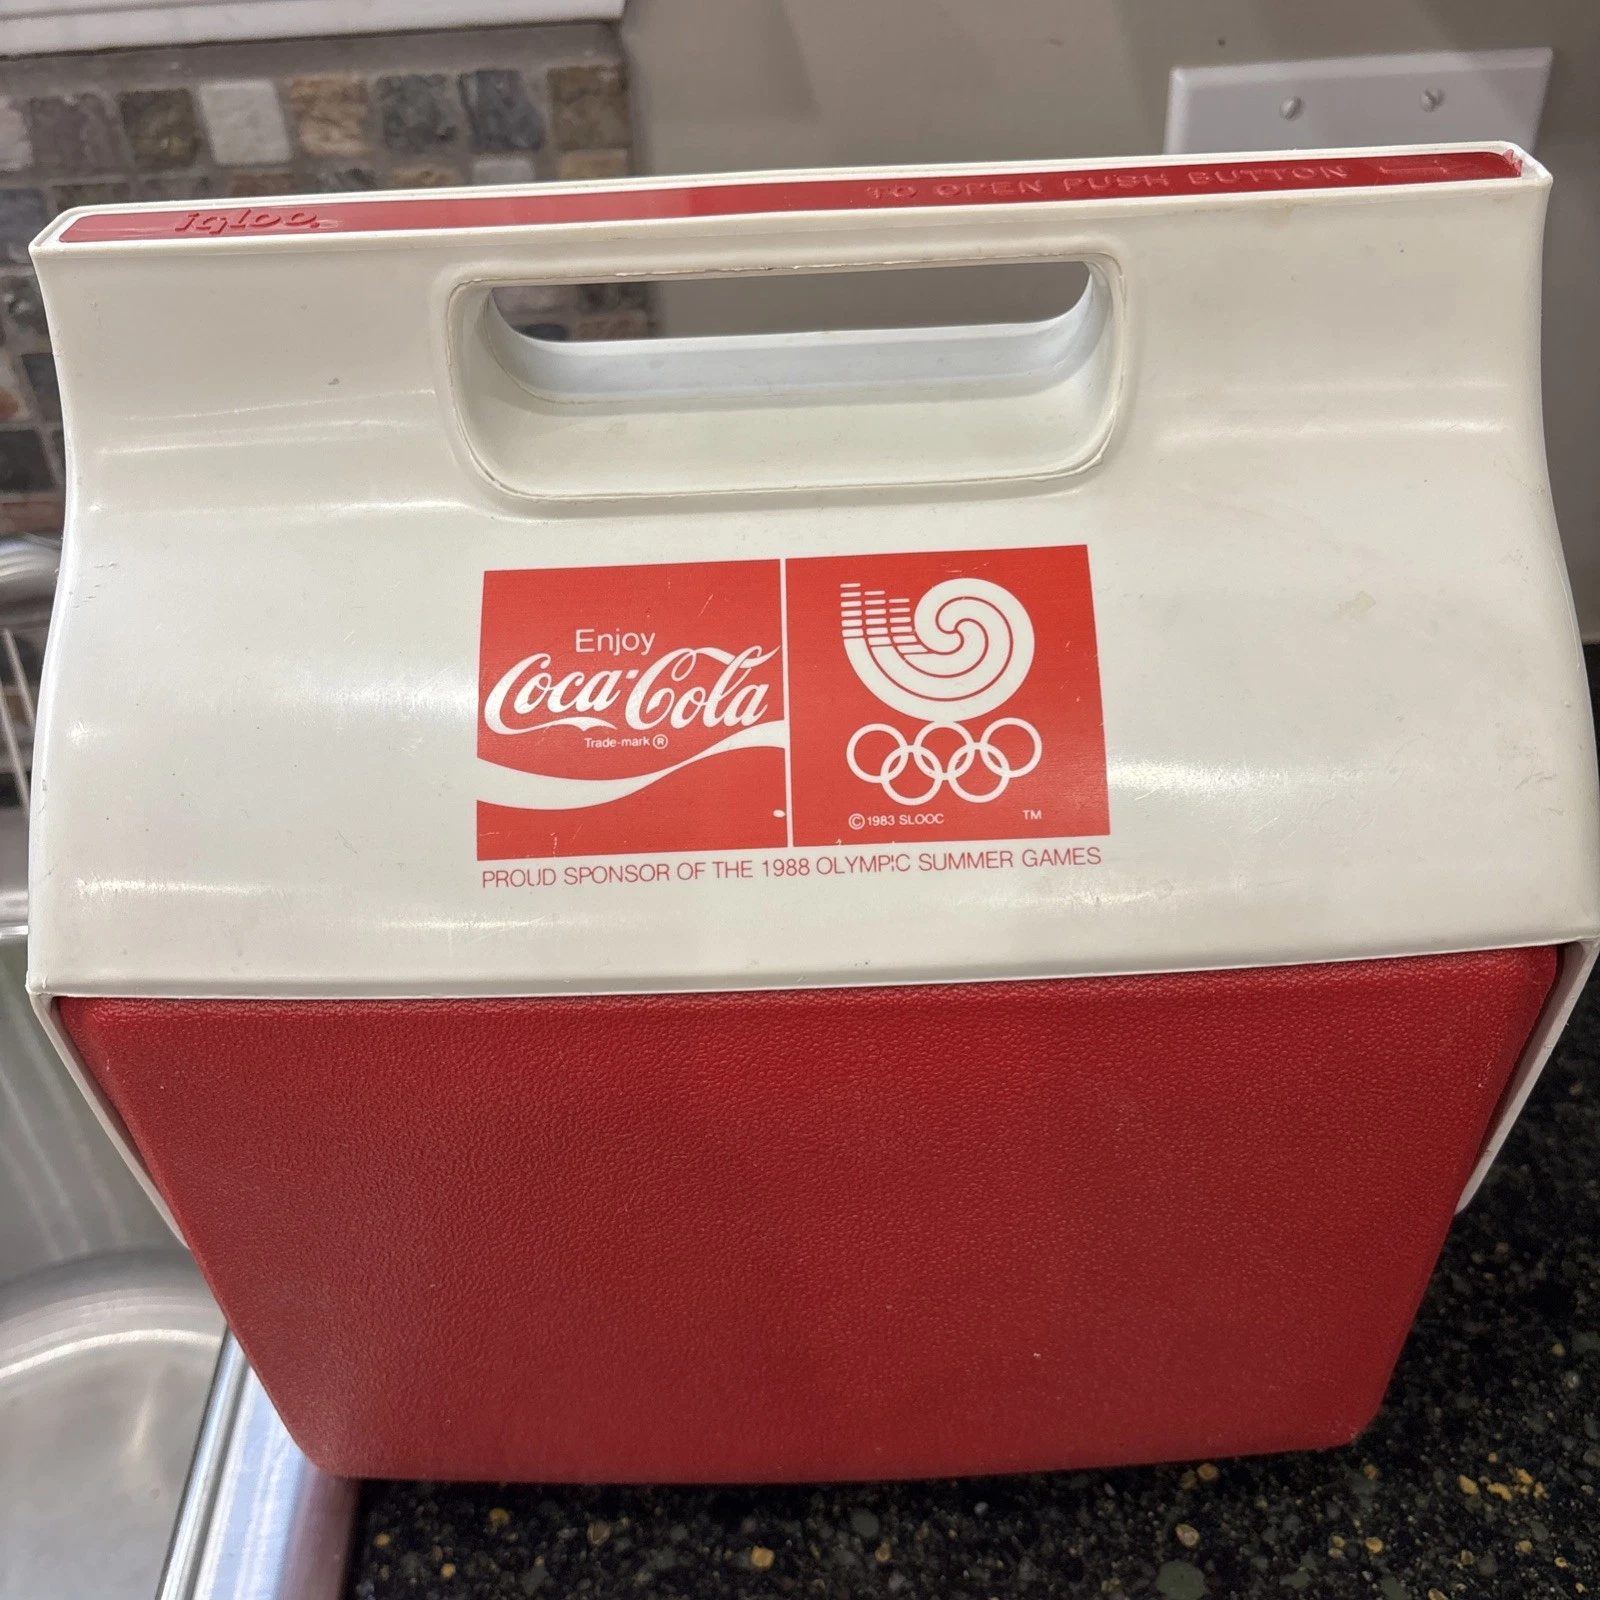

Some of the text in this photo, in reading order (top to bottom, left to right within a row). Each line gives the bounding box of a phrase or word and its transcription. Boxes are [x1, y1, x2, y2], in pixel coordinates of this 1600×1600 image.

[575, 627, 656, 656] Enjoy
[483, 644, 782, 736] Coca-Cola
[898, 812, 945, 826] SLOOC
[1022, 809, 1043, 821] TM
[481, 868, 557, 889] PROUD
[563, 863, 671, 886] SPONSOR
[676, 861, 707, 881] OF
[711, 860, 754, 879] THE
[761, 857, 811, 877] 1988
[918, 850, 1015, 871] SUMMER
[1021, 846, 1102, 867] GAMES
